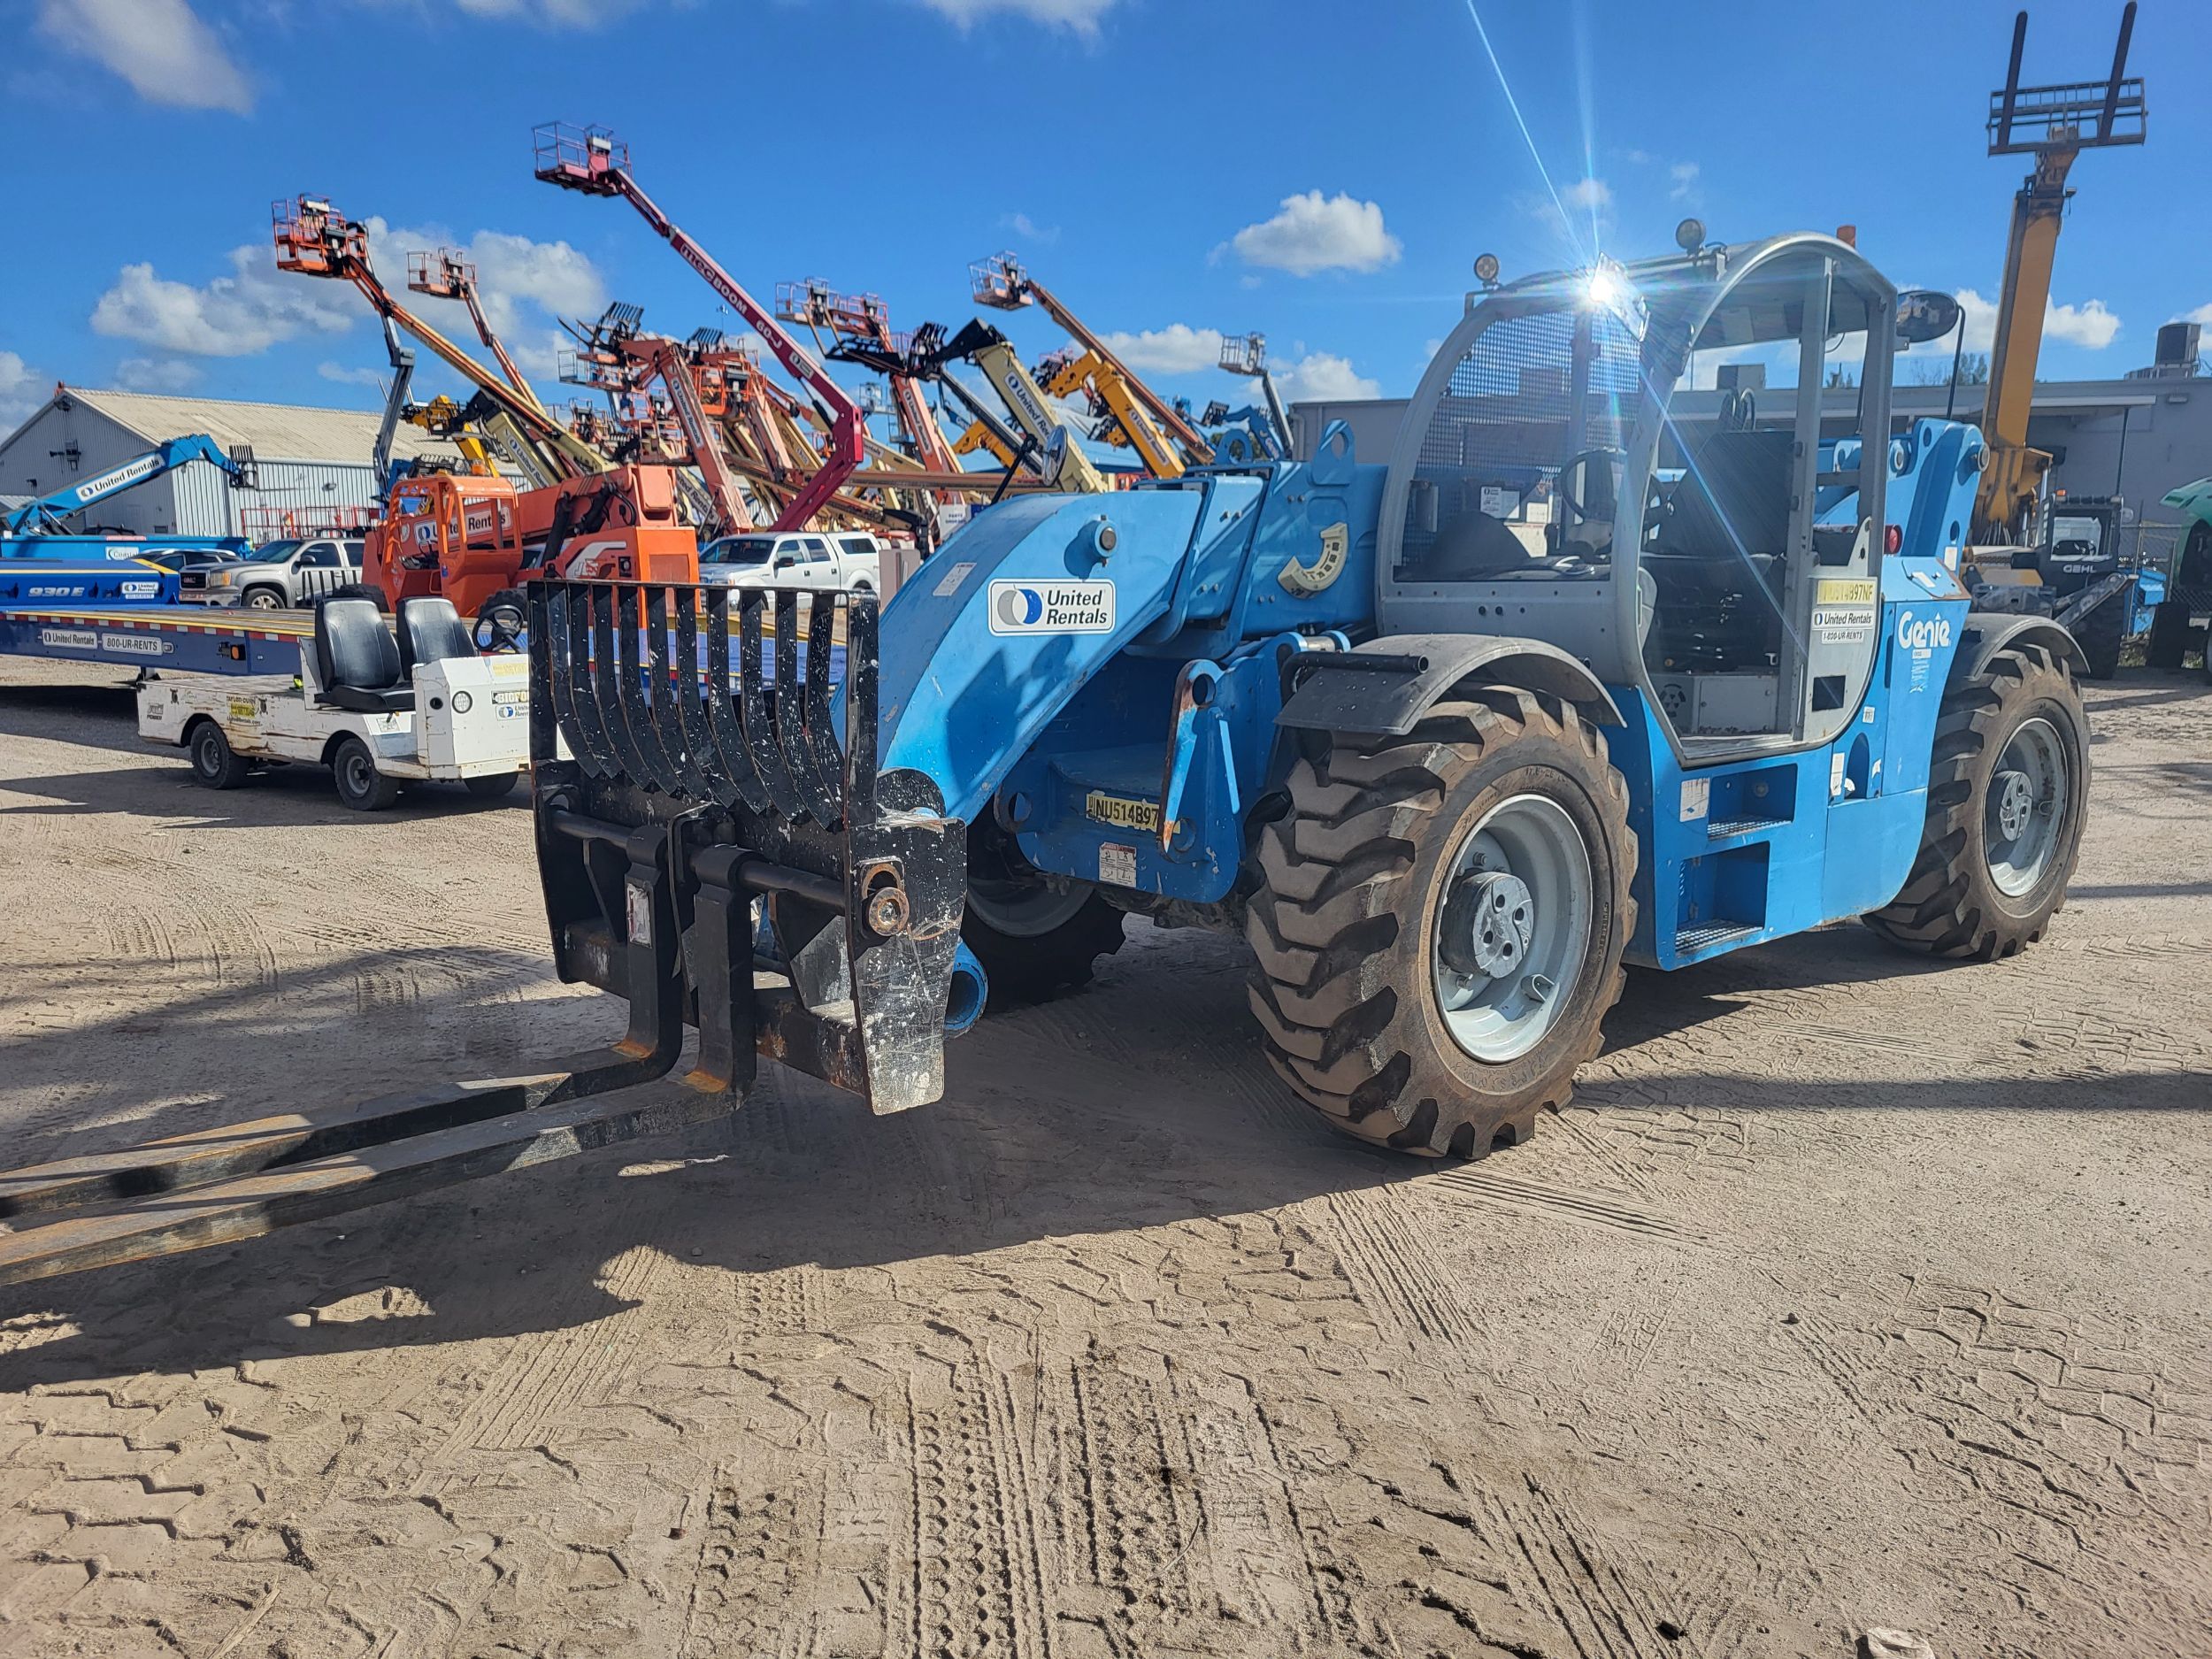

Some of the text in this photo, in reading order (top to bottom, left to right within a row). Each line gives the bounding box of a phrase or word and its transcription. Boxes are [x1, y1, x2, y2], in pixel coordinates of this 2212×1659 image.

[1016, 388, 1041, 421] United
[516, 448, 536, 473] United
[95, 458, 160, 491] United Rentals
[2062, 564, 2097, 574] GEHL
[28, 587, 85, 597] 930 E
[1047, 589, 1103, 606] United
[1046, 608, 1108, 625] Rentals
[1824, 612, 1872, 625] United Rentals
[1898, 611, 1950, 649] Genie
[52, 633, 95, 646] United Rentals
[106, 637, 157, 651] 800-UR-RENTS
[498, 690, 528, 704] BIGFO
